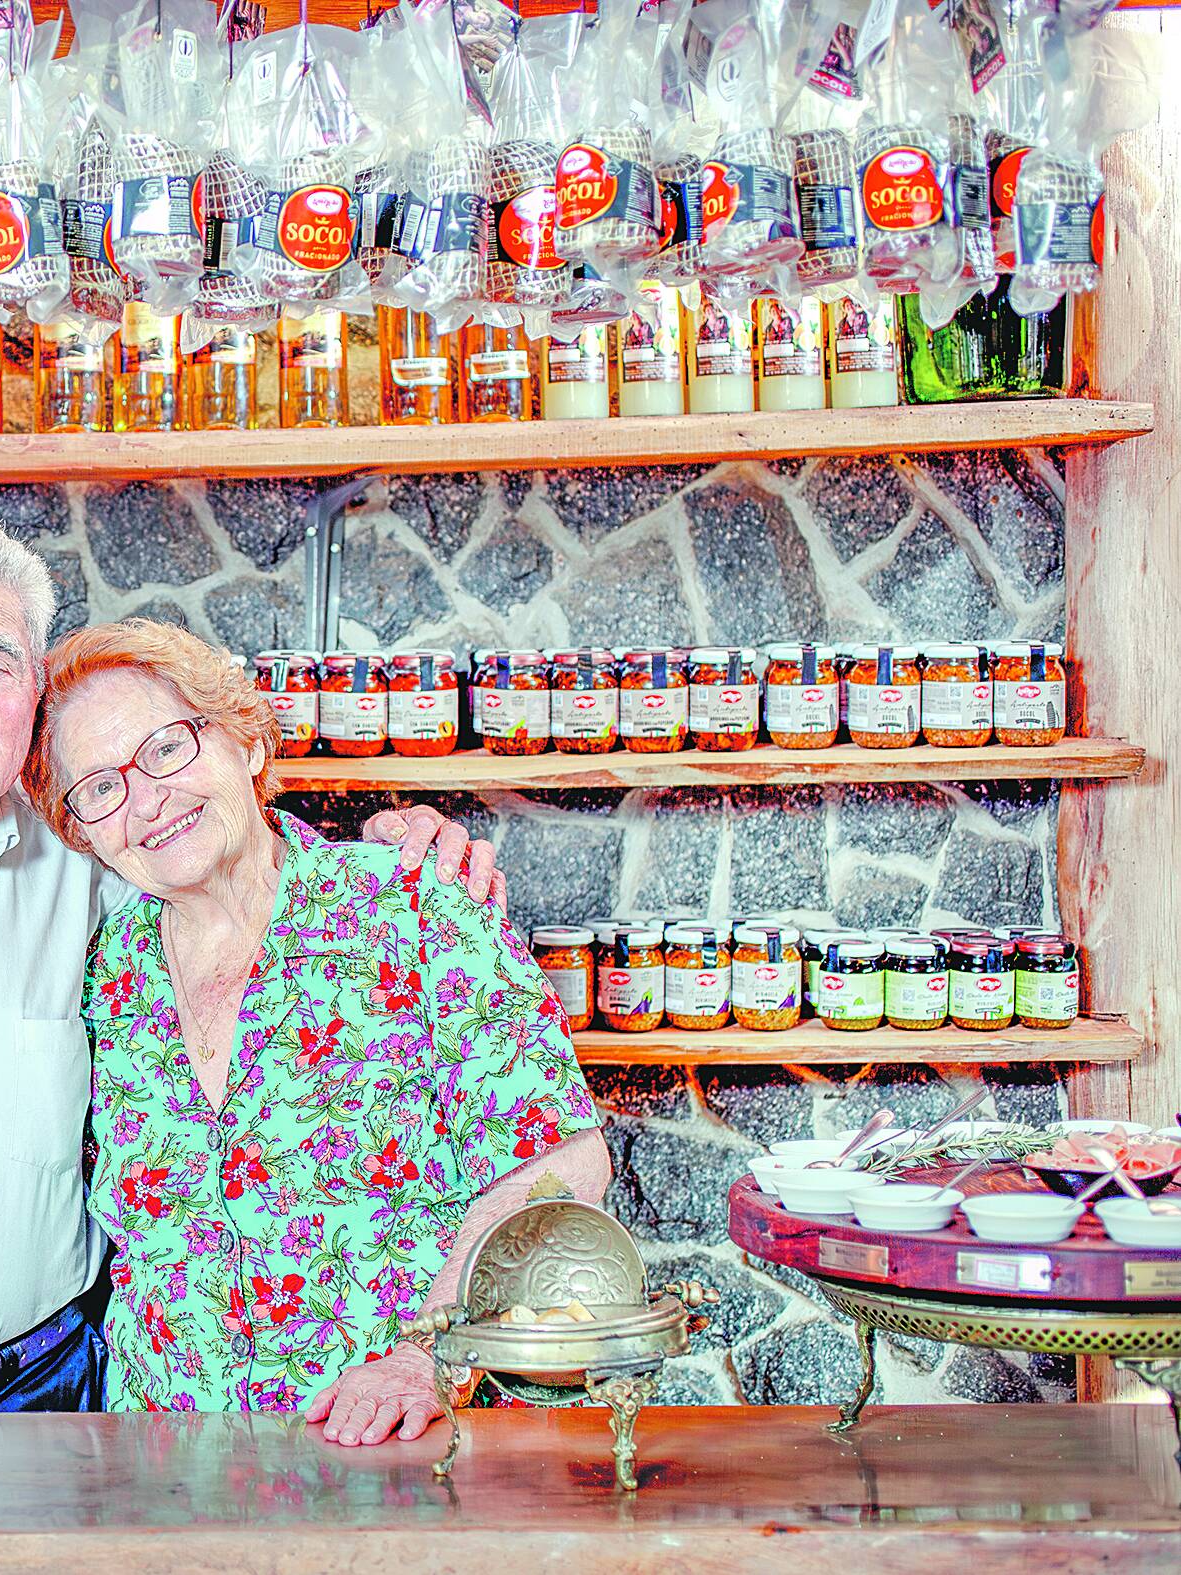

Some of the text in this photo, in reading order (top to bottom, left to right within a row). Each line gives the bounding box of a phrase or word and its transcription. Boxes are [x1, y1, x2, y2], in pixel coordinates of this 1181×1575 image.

[812, 73, 847, 94] OCOL
[871, 186, 938, 209] SOCOL
[286, 222, 348, 245] SOCOL
